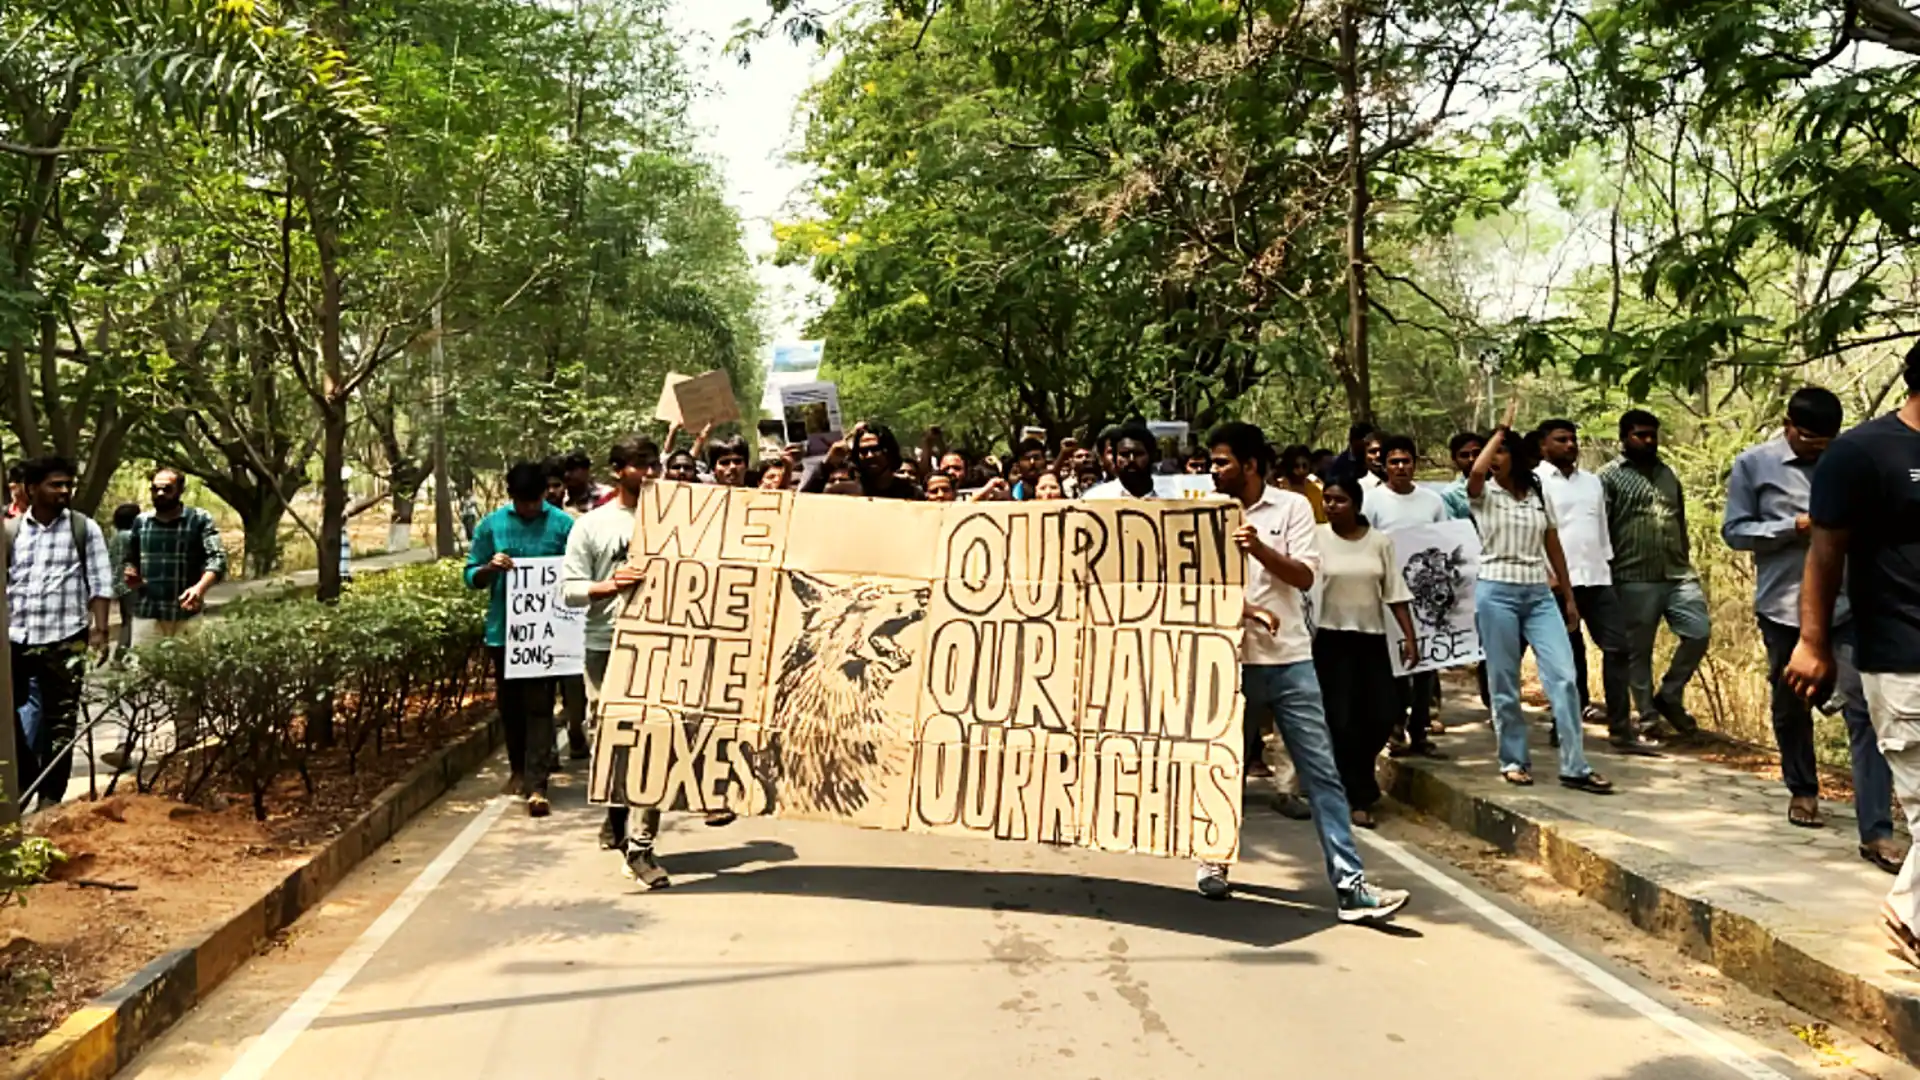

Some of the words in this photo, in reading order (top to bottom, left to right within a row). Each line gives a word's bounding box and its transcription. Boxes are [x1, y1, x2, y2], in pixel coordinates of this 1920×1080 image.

[642, 482, 783, 562] WE
[512, 566, 534, 590] IT
[541, 566, 557, 587] IS
[619, 557, 758, 631] ARE
[944, 505, 1115, 626] OUR
[1116, 503, 1245, 629] DEN
[508, 622, 537, 643] NOT
[542, 621, 555, 640] A
[613, 629, 751, 714] THE
[927, 618, 1067, 731] OUR
[1080, 627, 1241, 743] LAND
[588, 701, 771, 818] FOXES
[916, 712, 1036, 842] OUR
[1037, 730, 1241, 864] RIGHTS
